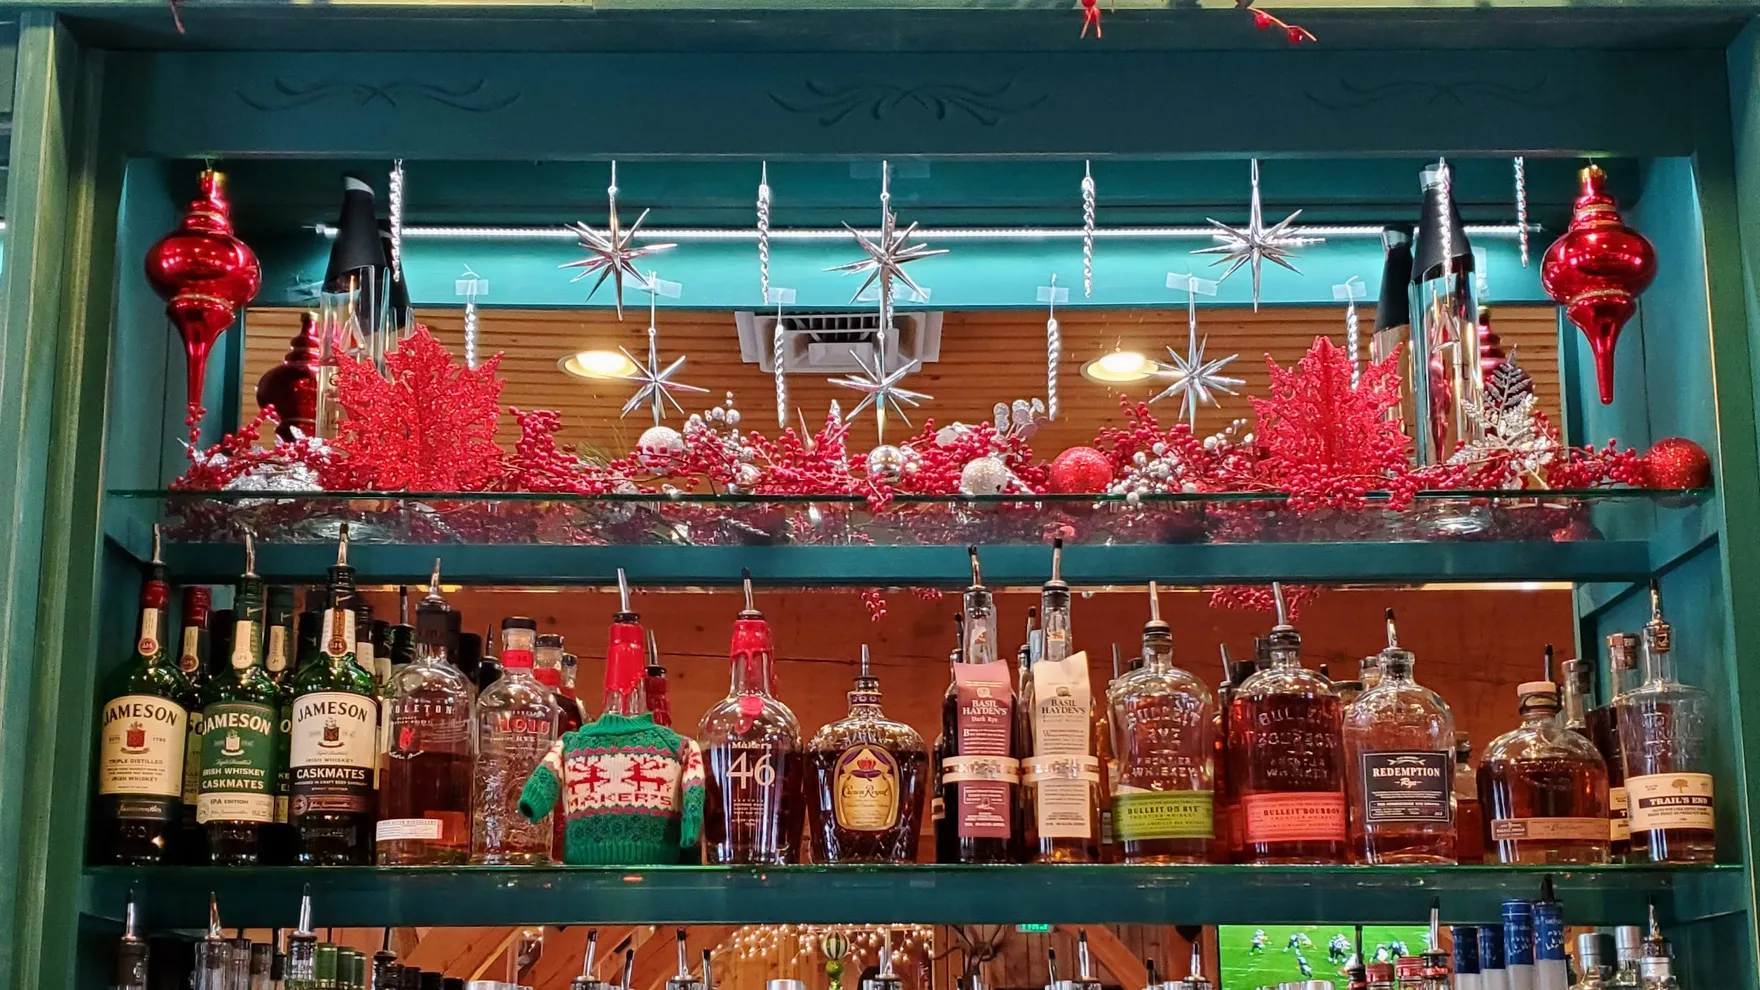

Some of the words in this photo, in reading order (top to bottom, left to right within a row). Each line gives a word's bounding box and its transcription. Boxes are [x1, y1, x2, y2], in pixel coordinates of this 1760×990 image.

[971, 699, 998, 708] BASIL
[1050, 699, 1077, 707] BASIL
[103, 703, 178, 727] JAMESON
[297, 701, 368, 722] JAMESON
[962, 706, 1009, 716] HAYDEN'S
[1041, 706, 1087, 715] HAYDEN'S
[202, 713, 272, 736] JAMESON
[987, 716, 999, 724] Rye
[203, 766, 222, 777] IRISH
[224, 767, 266, 777] WHISKEY
[296, 767, 366, 780] CASKMATES
[725, 751, 776, 790] 46
[1372, 766, 1440, 778] REDEMPTION
[202, 778, 265, 790] CASKMATES
[1399, 777, 1418, 789] Rye
[859, 784, 888, 798] Royal
[570, 792, 672, 807] MAKER'S
[1649, 796, 1690, 806] TRAIL'S
[1691, 796, 1708, 805] END
[1127, 805, 1165, 815] BULLEIT
[1182, 805, 1201, 813] RYE
[1263, 807, 1301, 816] BULLEIT
[1302, 807, 1340, 815] BOURBON
